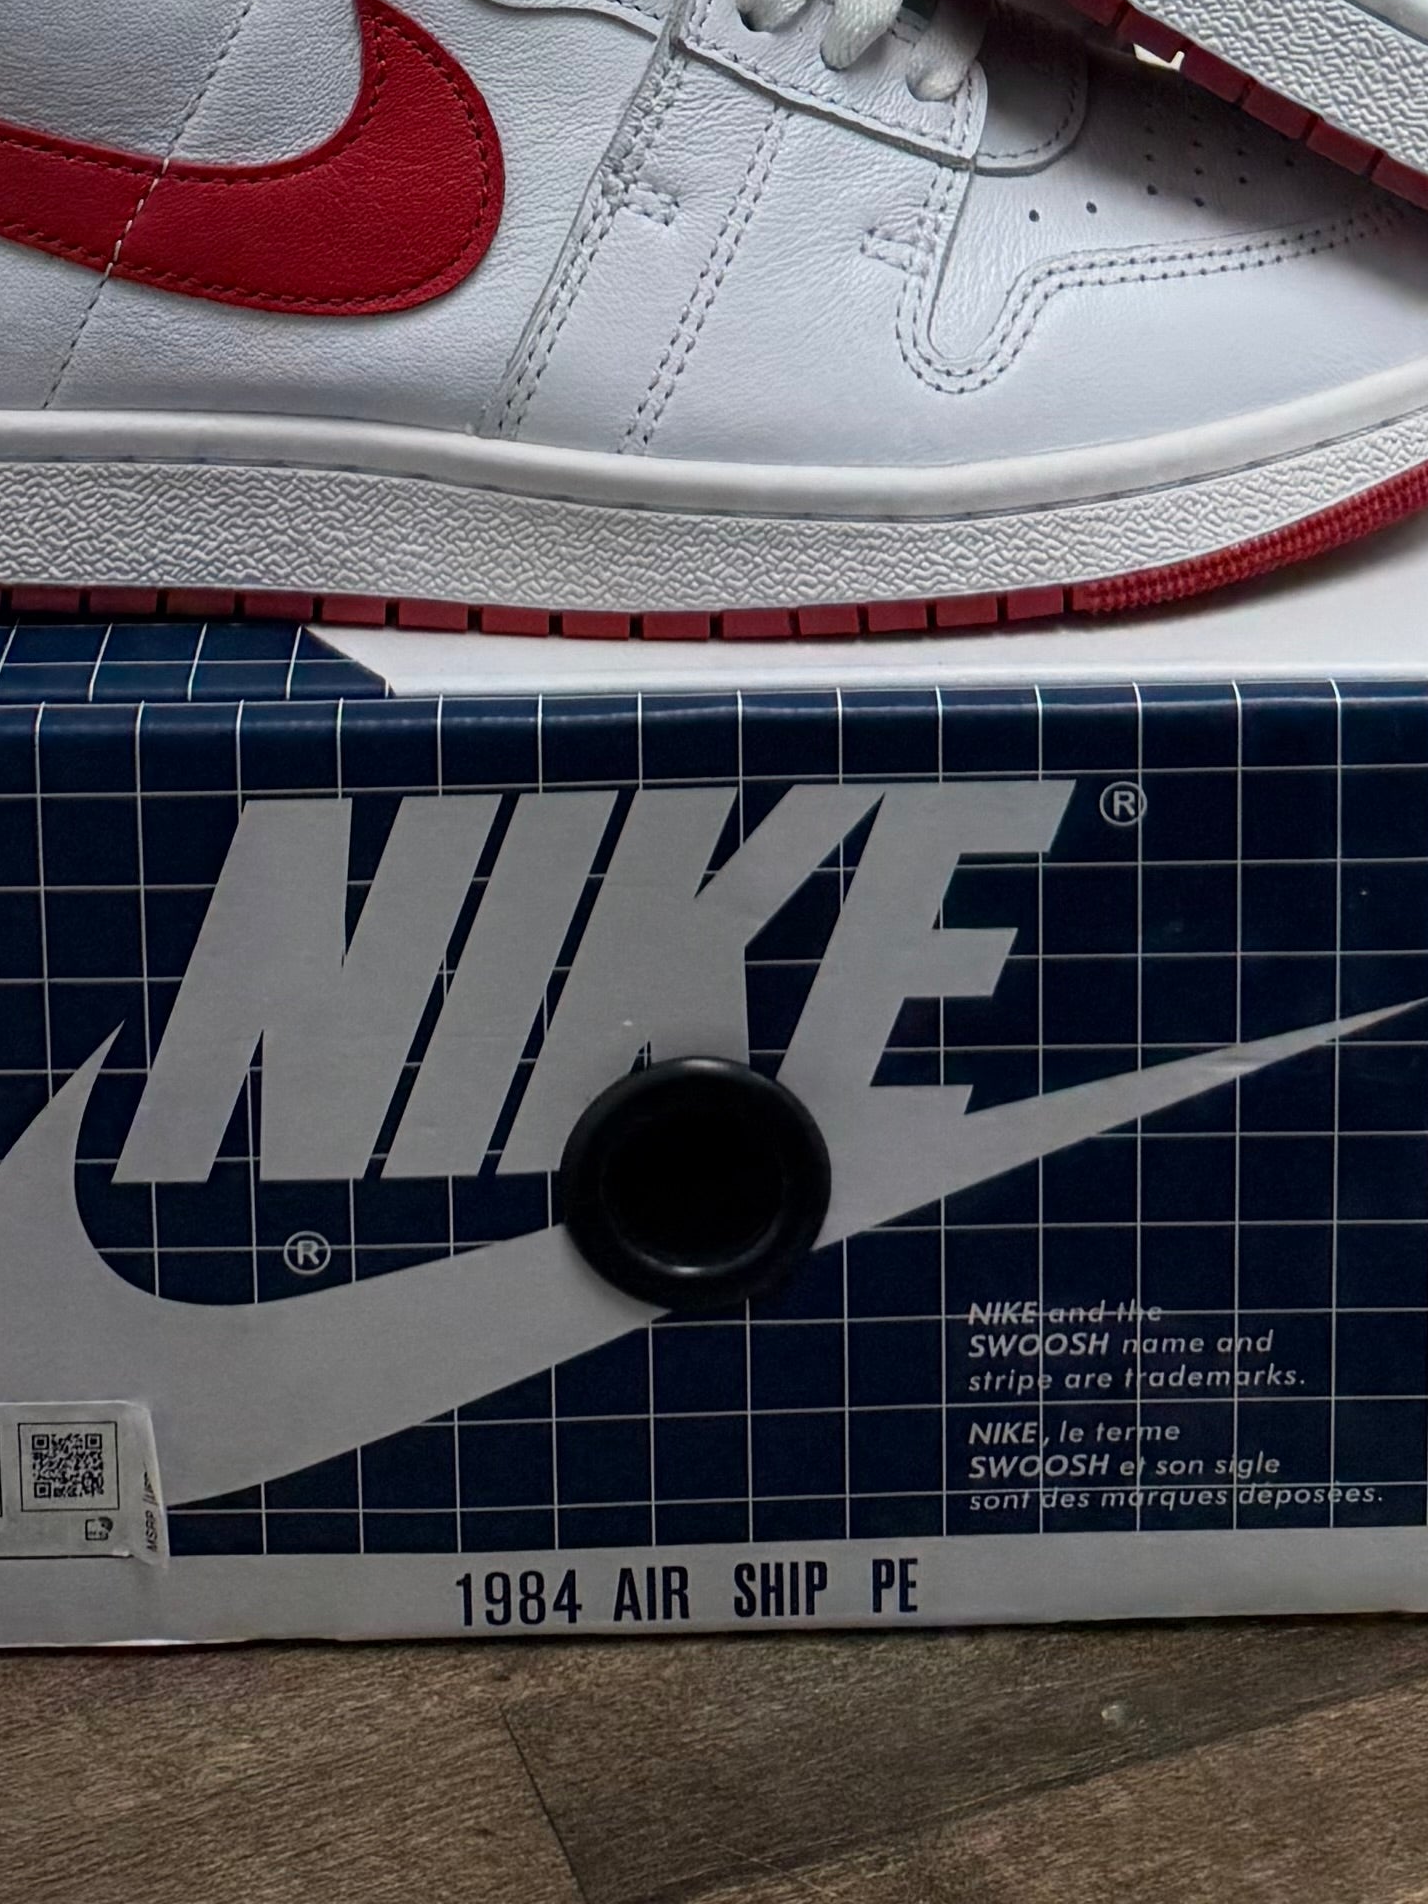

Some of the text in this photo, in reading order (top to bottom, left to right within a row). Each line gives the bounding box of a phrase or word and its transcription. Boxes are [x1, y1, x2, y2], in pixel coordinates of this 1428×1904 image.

[112, 780, 1076, 1183] NIKE
[968, 1299, 1163, 1326] NIKE and the
[968, 1329, 1274, 1357] SWOOSH name and
[968, 1363, 1306, 1396] stripe are trademarks.
[968, 1419, 1181, 1448] NIKE, le terme
[968, 1451, 1281, 1481] SWOOSH et son sigle
[969, 1491, 1029, 1511] sont
[1040, 1485, 1090, 1509] des
[1100, 1488, 1228, 1512] marques
[456, 1557, 918, 1627] 1984 AIR SHIP PE
